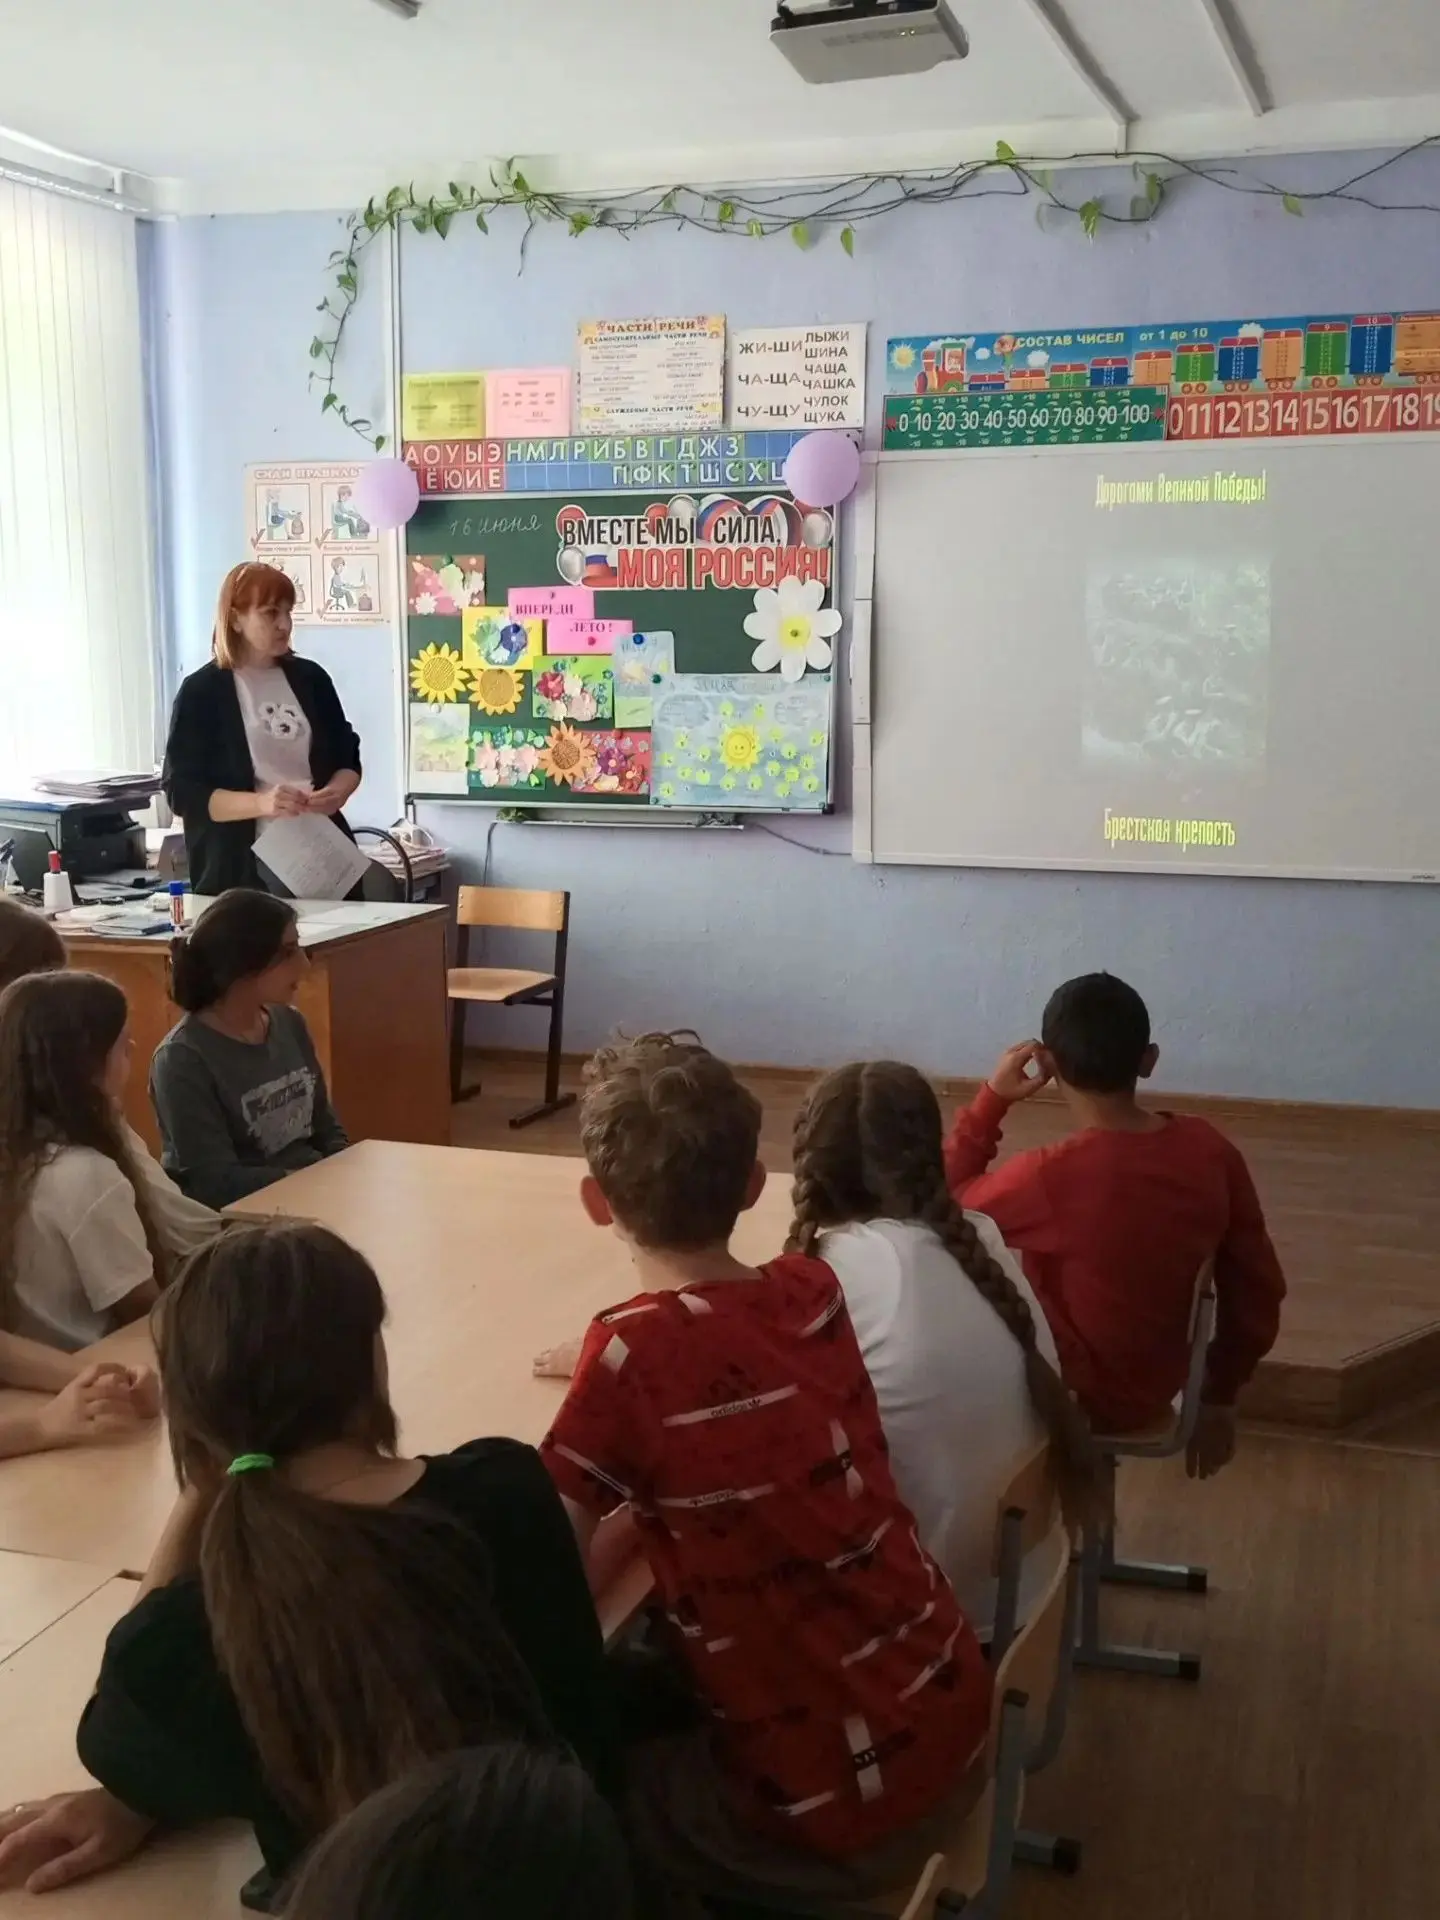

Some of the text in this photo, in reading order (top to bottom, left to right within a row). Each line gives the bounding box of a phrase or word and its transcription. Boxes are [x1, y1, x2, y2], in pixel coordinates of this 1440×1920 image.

[607, 321, 695, 333] ЧАСТИ РЕЧИ
[805, 331, 850, 343] ЛЫЖИ
[1016, 327, 1208, 348] СОСТАВ ЧИСЕЛ от 1 до 10
[739, 340, 802, 354] ЖИ-ШИ
[805, 346, 848, 358] ШИНА
[805, 363, 847, 375] ЧАЩА
[738, 372, 801, 386] ЧА-ЩА
[803, 378, 856, 390] ЧАШКА
[804, 395, 849, 407] ЧУЛОК
[737, 404, 801, 418] ЧУ-ЩУ
[804, 411, 846, 424] ЩУКА
[899, 404, 1150, 432] 0 10 20 30 40 50 60 70 80 90 100
[1170, 403, 1184, 435] 0
[1187, 402, 1212, 434] 11
[1215, 401, 1242, 433] 12
[1243, 400, 1270, 432] 13
[1273, 399, 1300, 431] 14
[1303, 397, 1330, 430] 15
[1332, 396, 1360, 429] 16
[1362, 394, 1391, 427] 17
[1392, 393, 1420, 426] 18
[295, 467, 364, 479] ПРАВИЛЬ
[1095, 468, 1267, 511] Дорогами Великой Победы!
[449, 514, 543, 536] 16 июня
[563, 516, 782, 546] ВМЕСТЕ МЫ СИЛА,
[618, 546, 829, 588] МОЯ РОССИЯ!
[515, 603, 574, 616] ВПЕРЕДИ
[569, 622, 613, 633] ЛЕТО!
[1103, 808, 1236, 853] Брестская крепость
